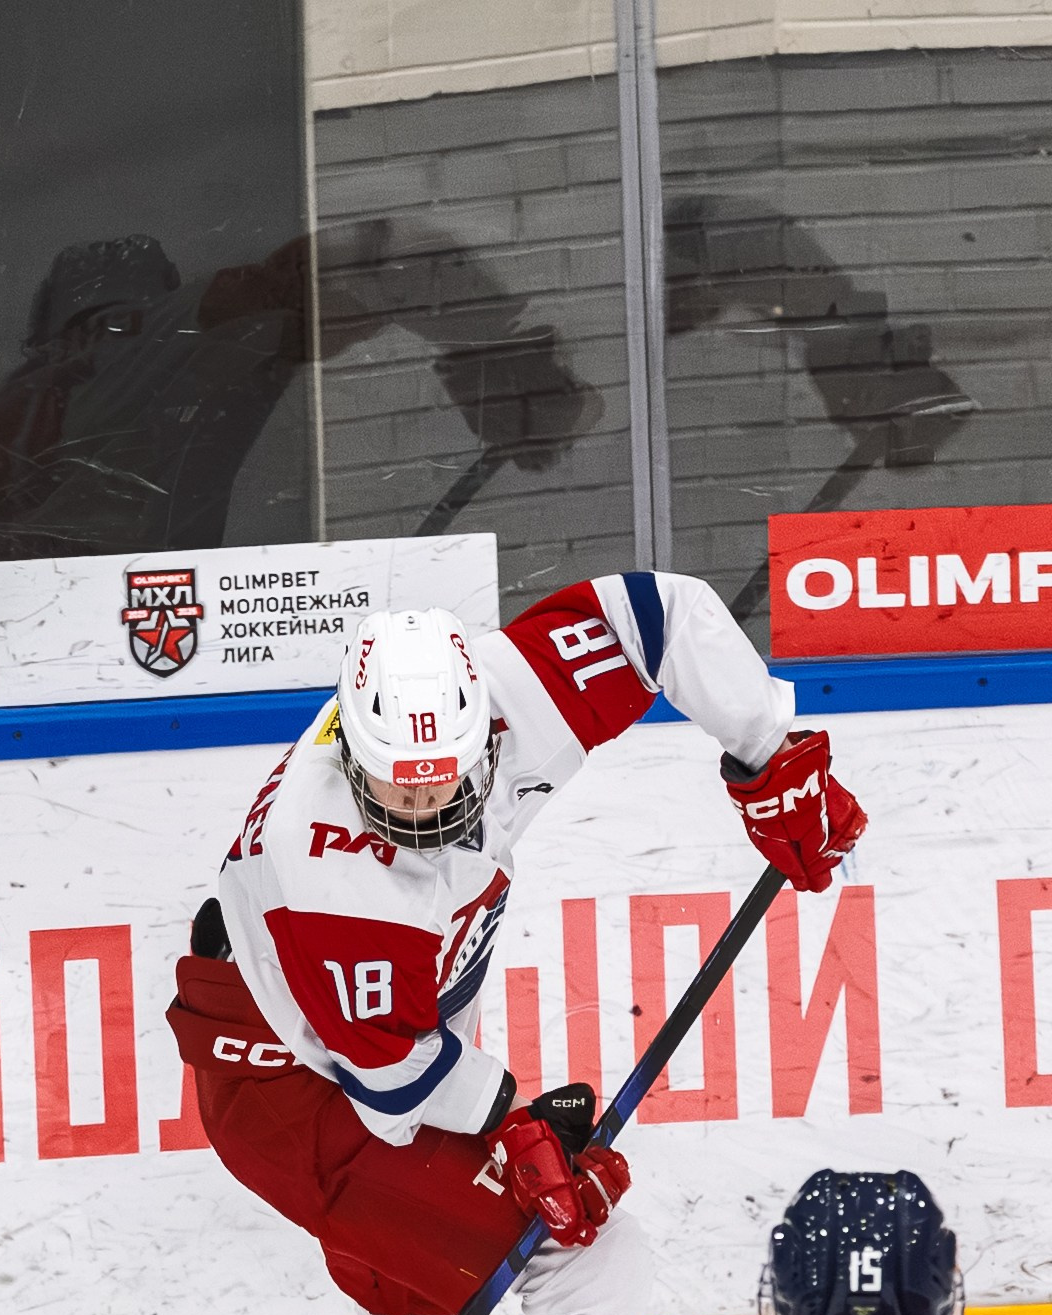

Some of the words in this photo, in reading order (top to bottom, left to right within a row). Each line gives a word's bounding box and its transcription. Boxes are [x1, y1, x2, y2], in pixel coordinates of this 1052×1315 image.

[219, 570, 320, 591] OLIMPBET
[130, 585, 193, 607] МХЛ
[220, 591, 370, 615] МОЛОДЕЖНАЯ
[221, 617, 345, 639] ХОККЕЙНАЯ
[221, 645, 275, 664] ЛИГА
[548, 617, 628, 692] 18
[408, 712, 437, 743] 18
[395, 772, 454, 785] OLIMPBET
[323, 959, 393, 1023] 18
[212, 1035, 305, 1067] CC
[551, 1097, 586, 1108] CCM
[848, 1249, 883, 1292] 15
